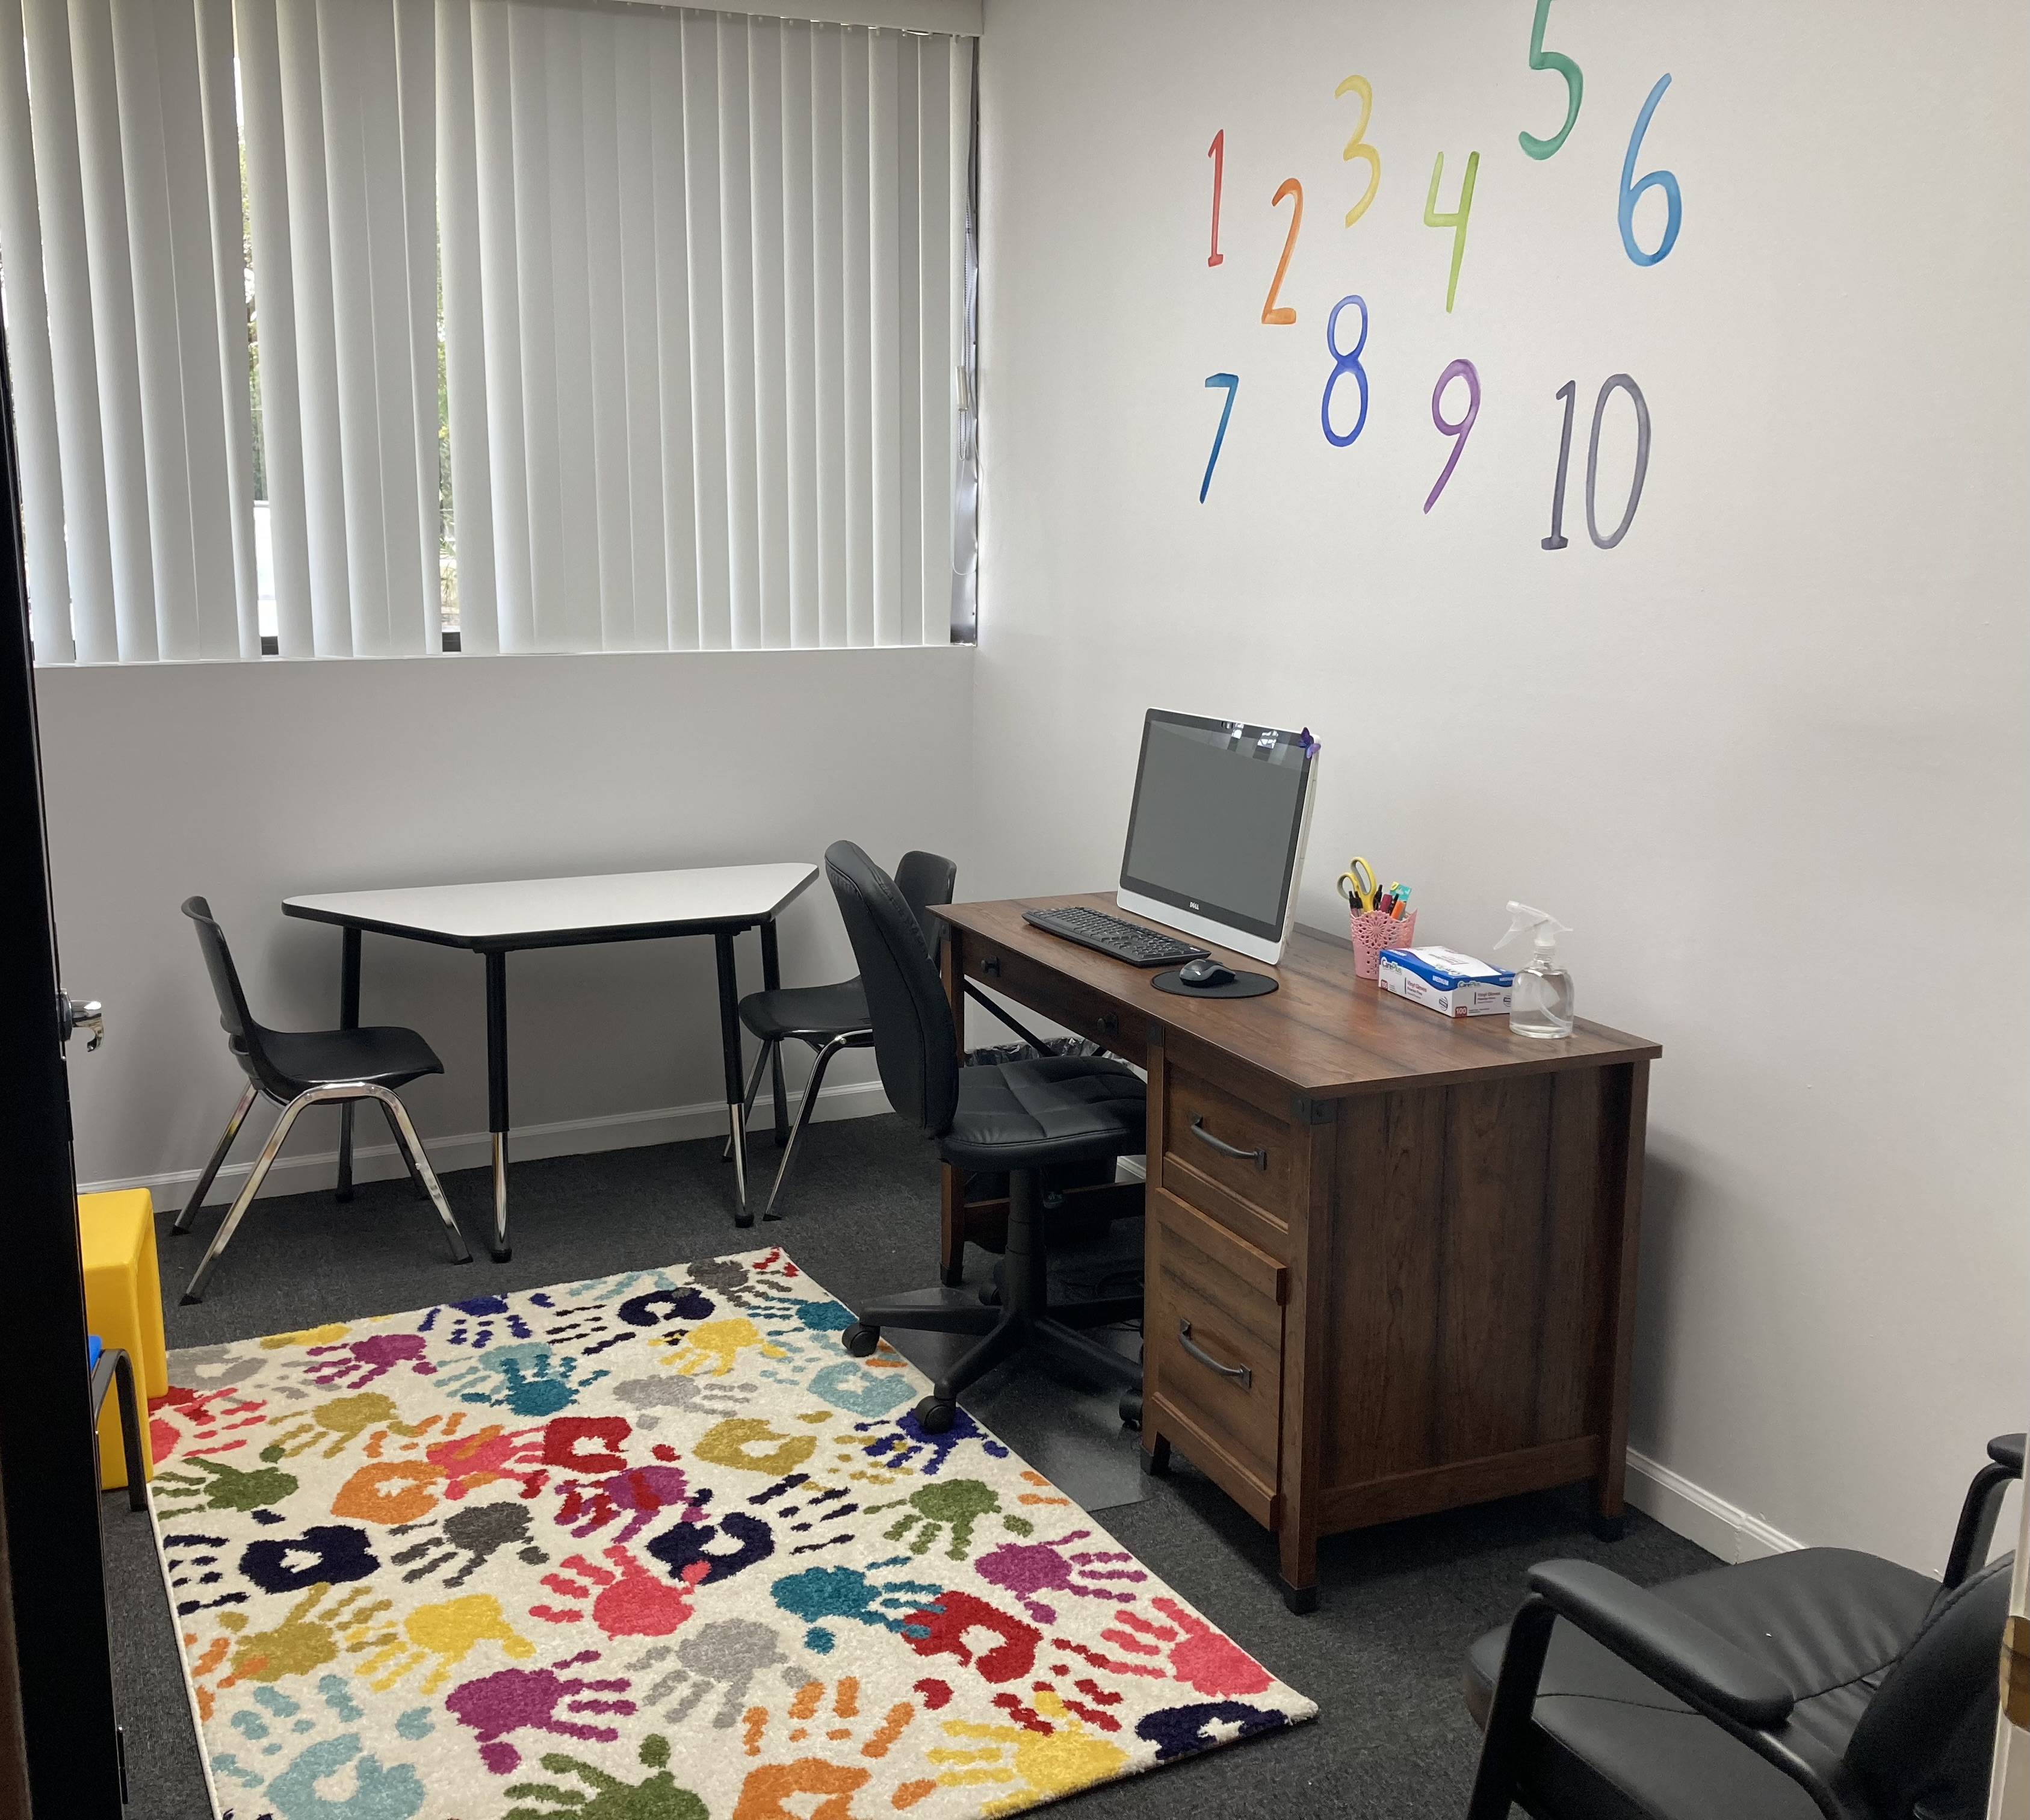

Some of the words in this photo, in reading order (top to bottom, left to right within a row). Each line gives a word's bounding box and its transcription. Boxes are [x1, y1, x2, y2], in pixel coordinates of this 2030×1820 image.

[1334, 75, 1381, 228] 3
[1518, 0, 1583, 161] 5
[1208, 129, 1224, 267] 1
[1423, 151, 1480, 314] 4
[1617, 73, 1682, 267] 6
[1261, 178, 1304, 325] 2
[1199, 373, 1239, 504] 7
[1321, 294, 1369, 448] 8
[1423, 359, 1481, 515] 9
[1541, 373, 1651, 551] 10
[1189, 902, 1199, 910] DELL
[1382, 959, 1402, 974] CarePlus
